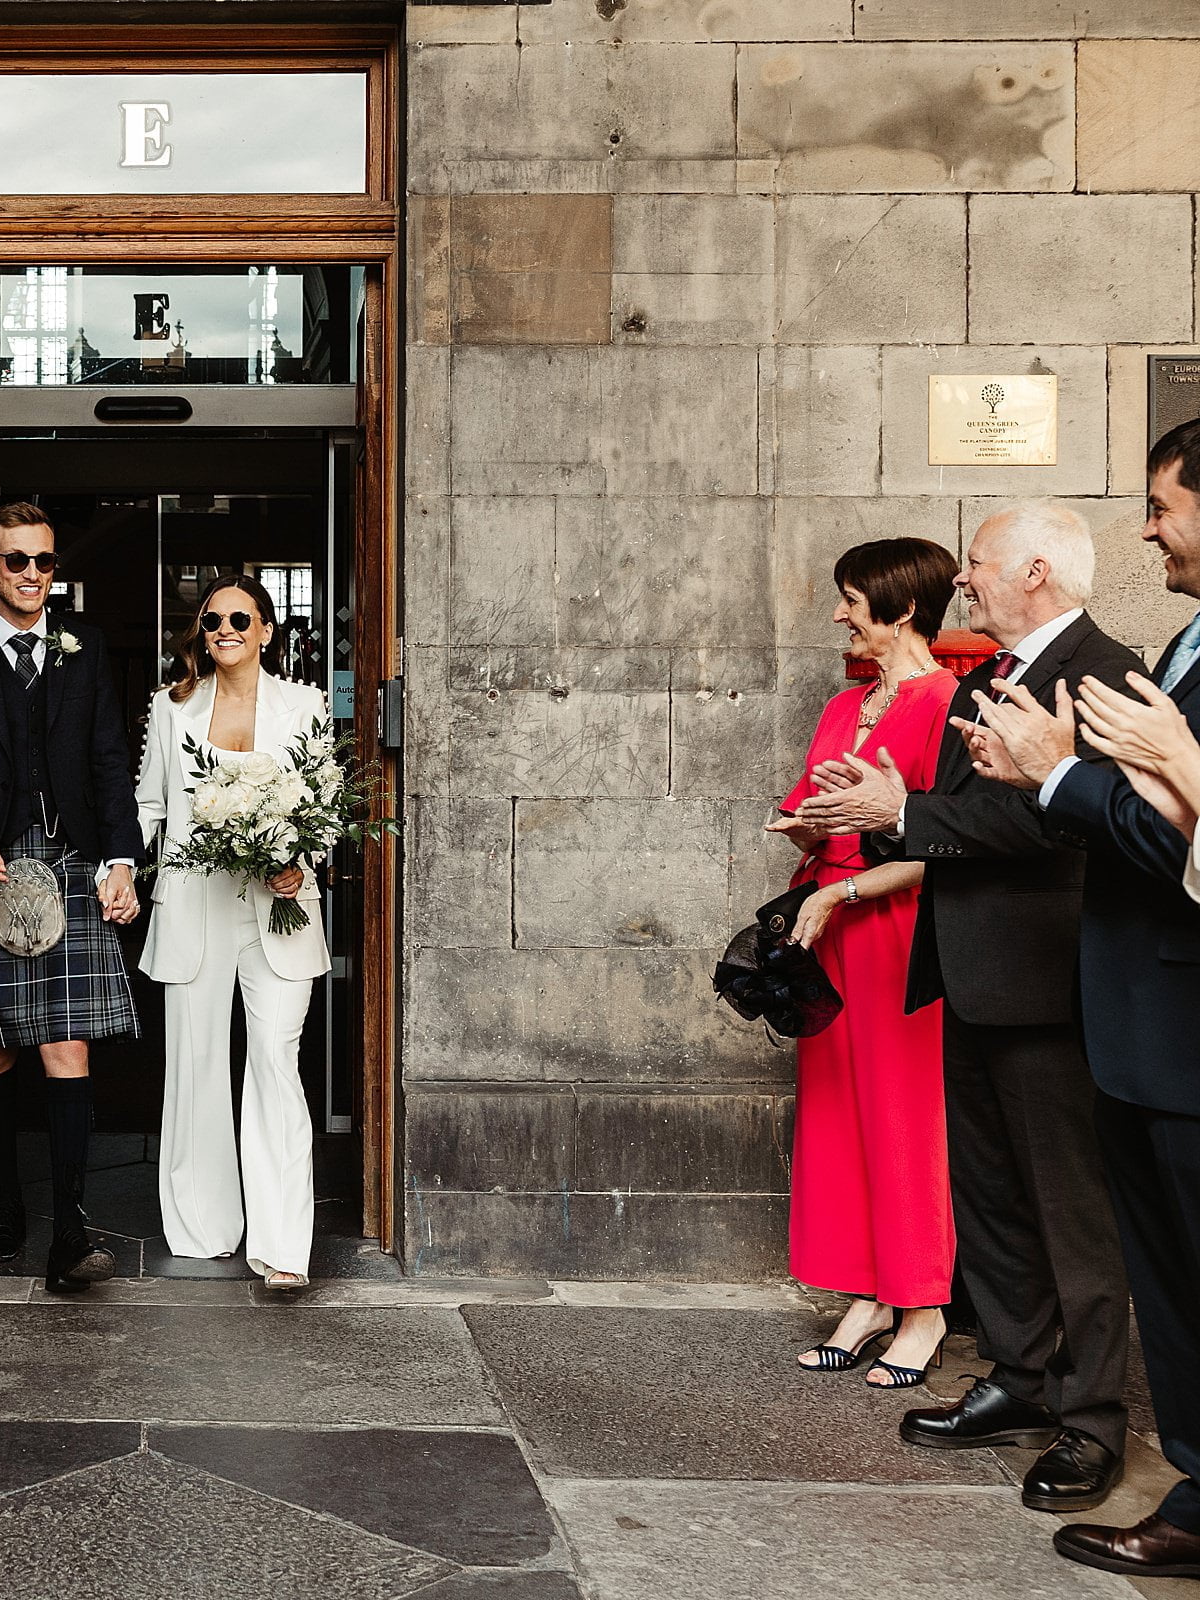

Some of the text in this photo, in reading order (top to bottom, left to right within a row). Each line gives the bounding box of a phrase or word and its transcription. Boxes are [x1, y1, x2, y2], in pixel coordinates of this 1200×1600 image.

[119, 100, 173, 168] E
[133, 293, 172, 341] E
[1168, 375, 1200, 383] TOWNS
